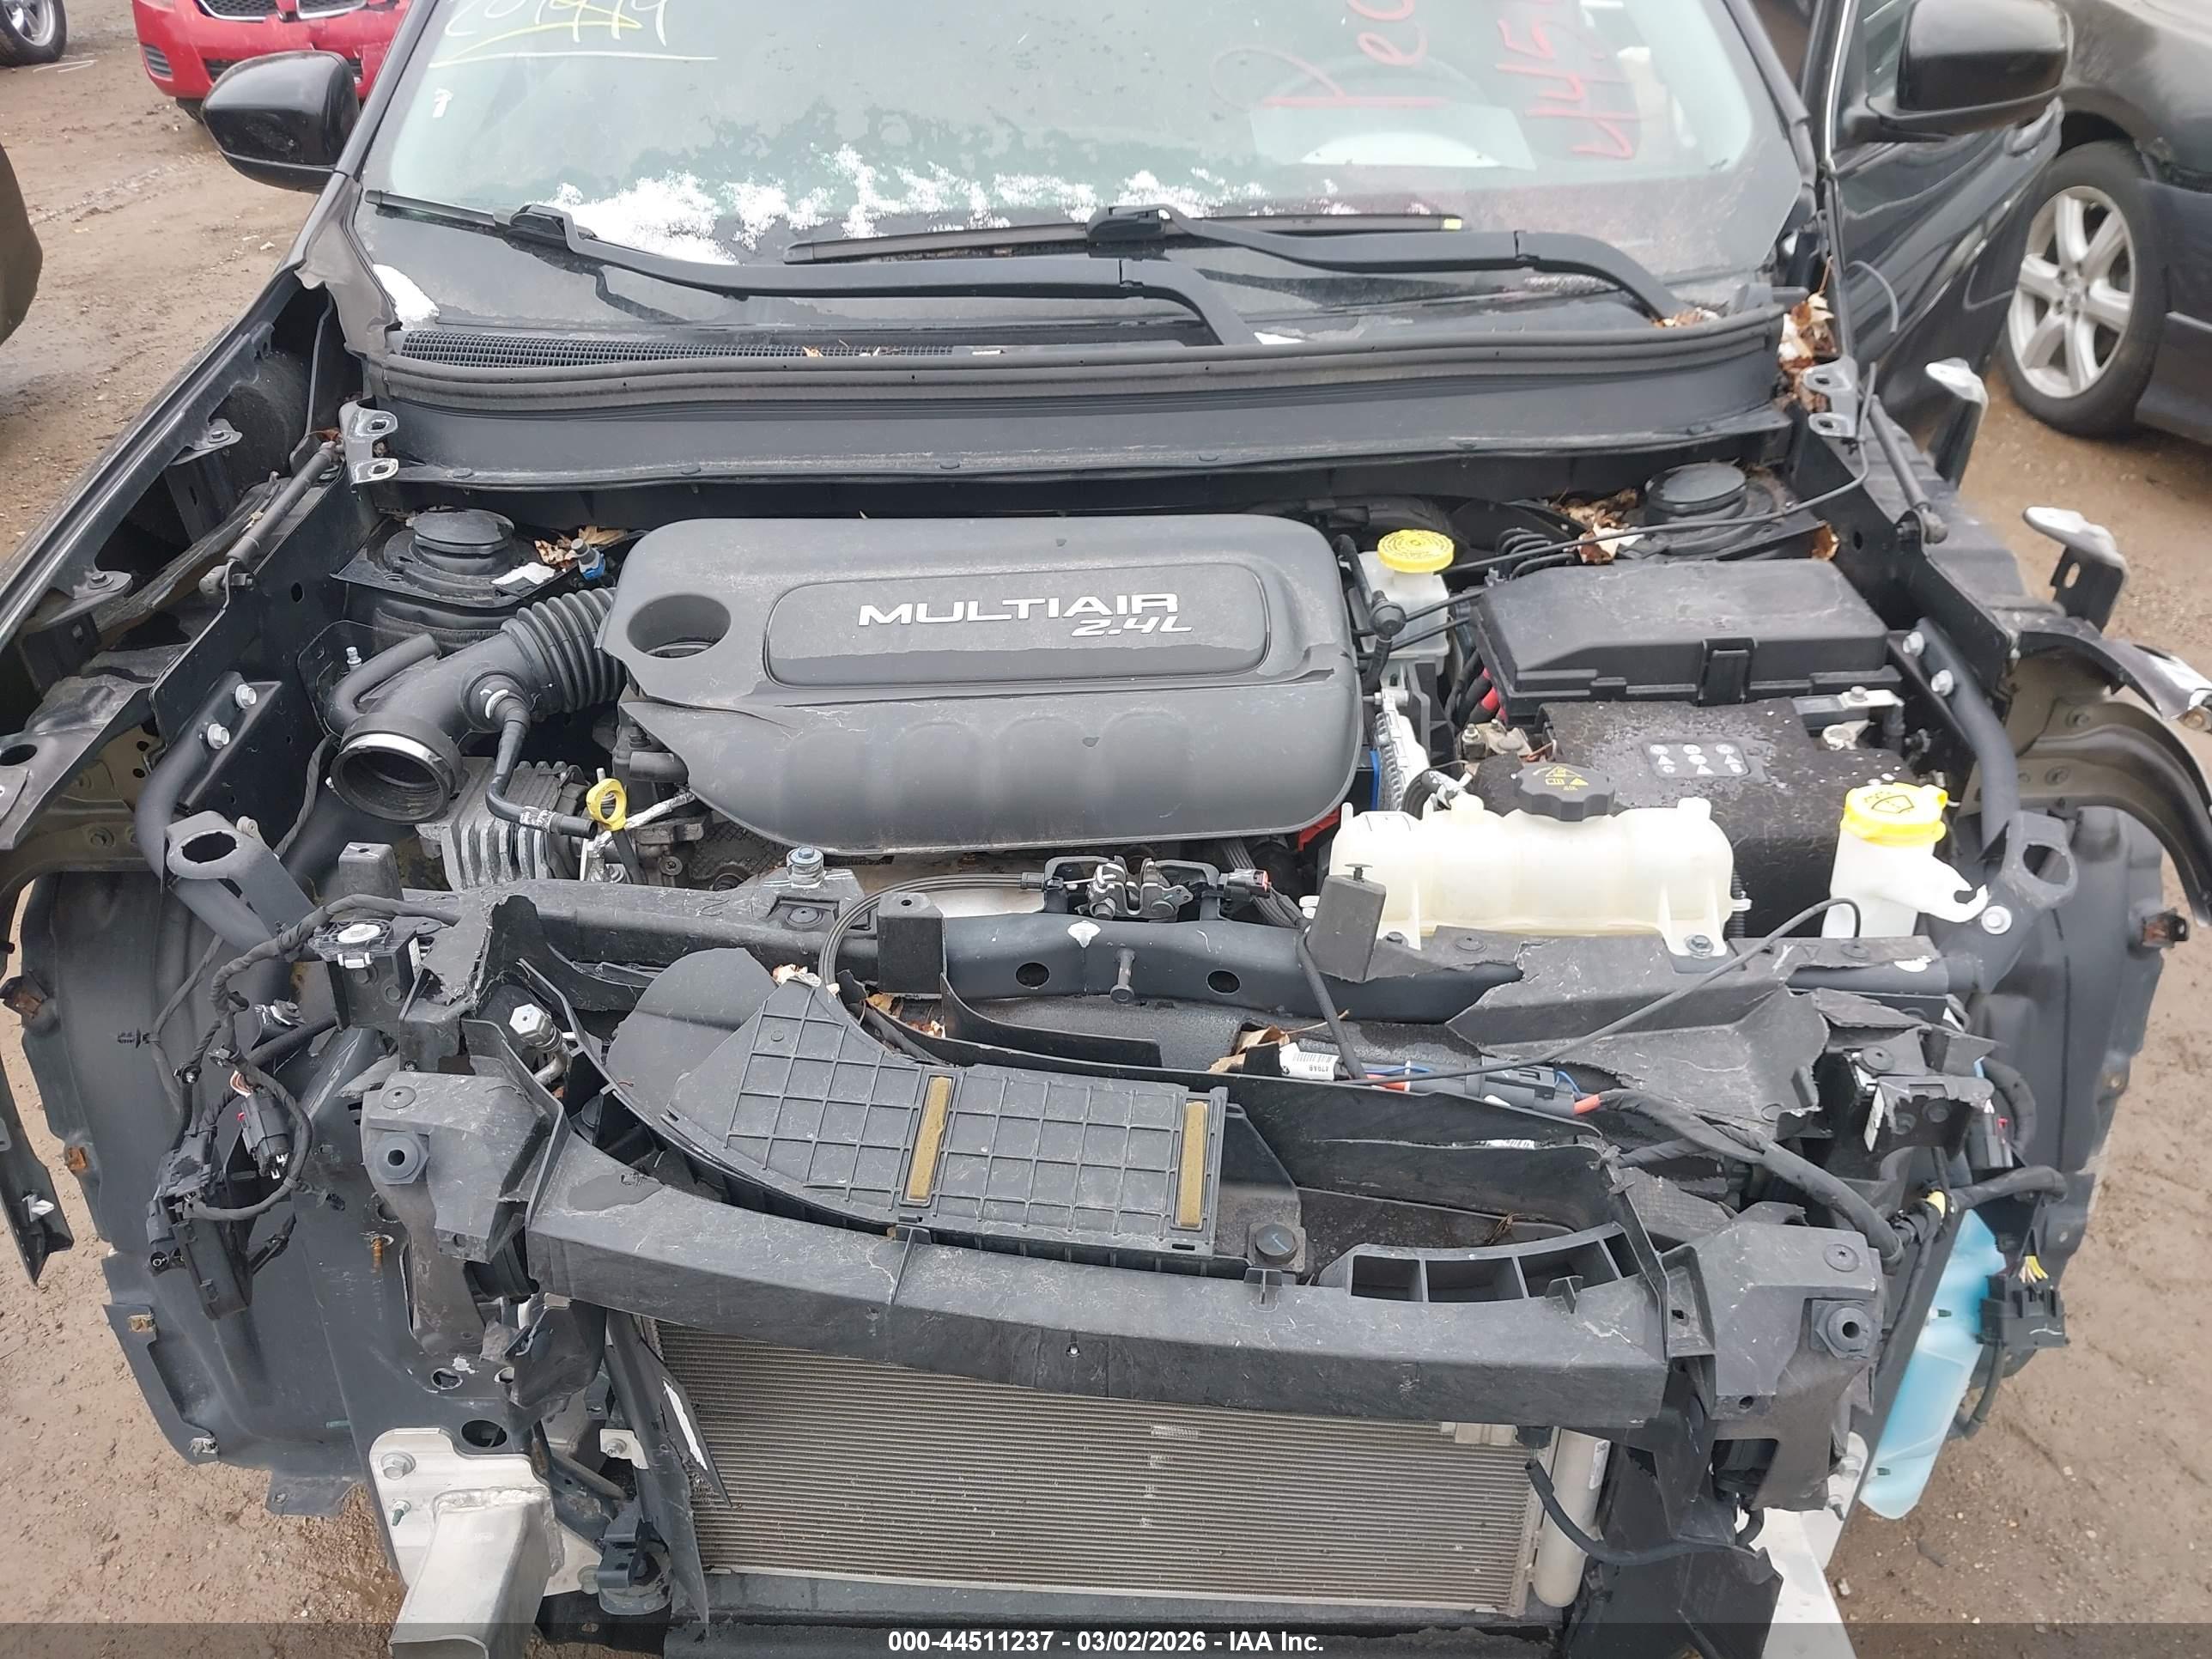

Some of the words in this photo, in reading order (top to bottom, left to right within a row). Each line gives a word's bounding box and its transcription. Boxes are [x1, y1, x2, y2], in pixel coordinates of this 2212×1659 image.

[1495, 0, 1642, 161] 445
[857, 592, 1179, 627] MULTIAIR
[1071, 615, 1194, 638] 2.4L
